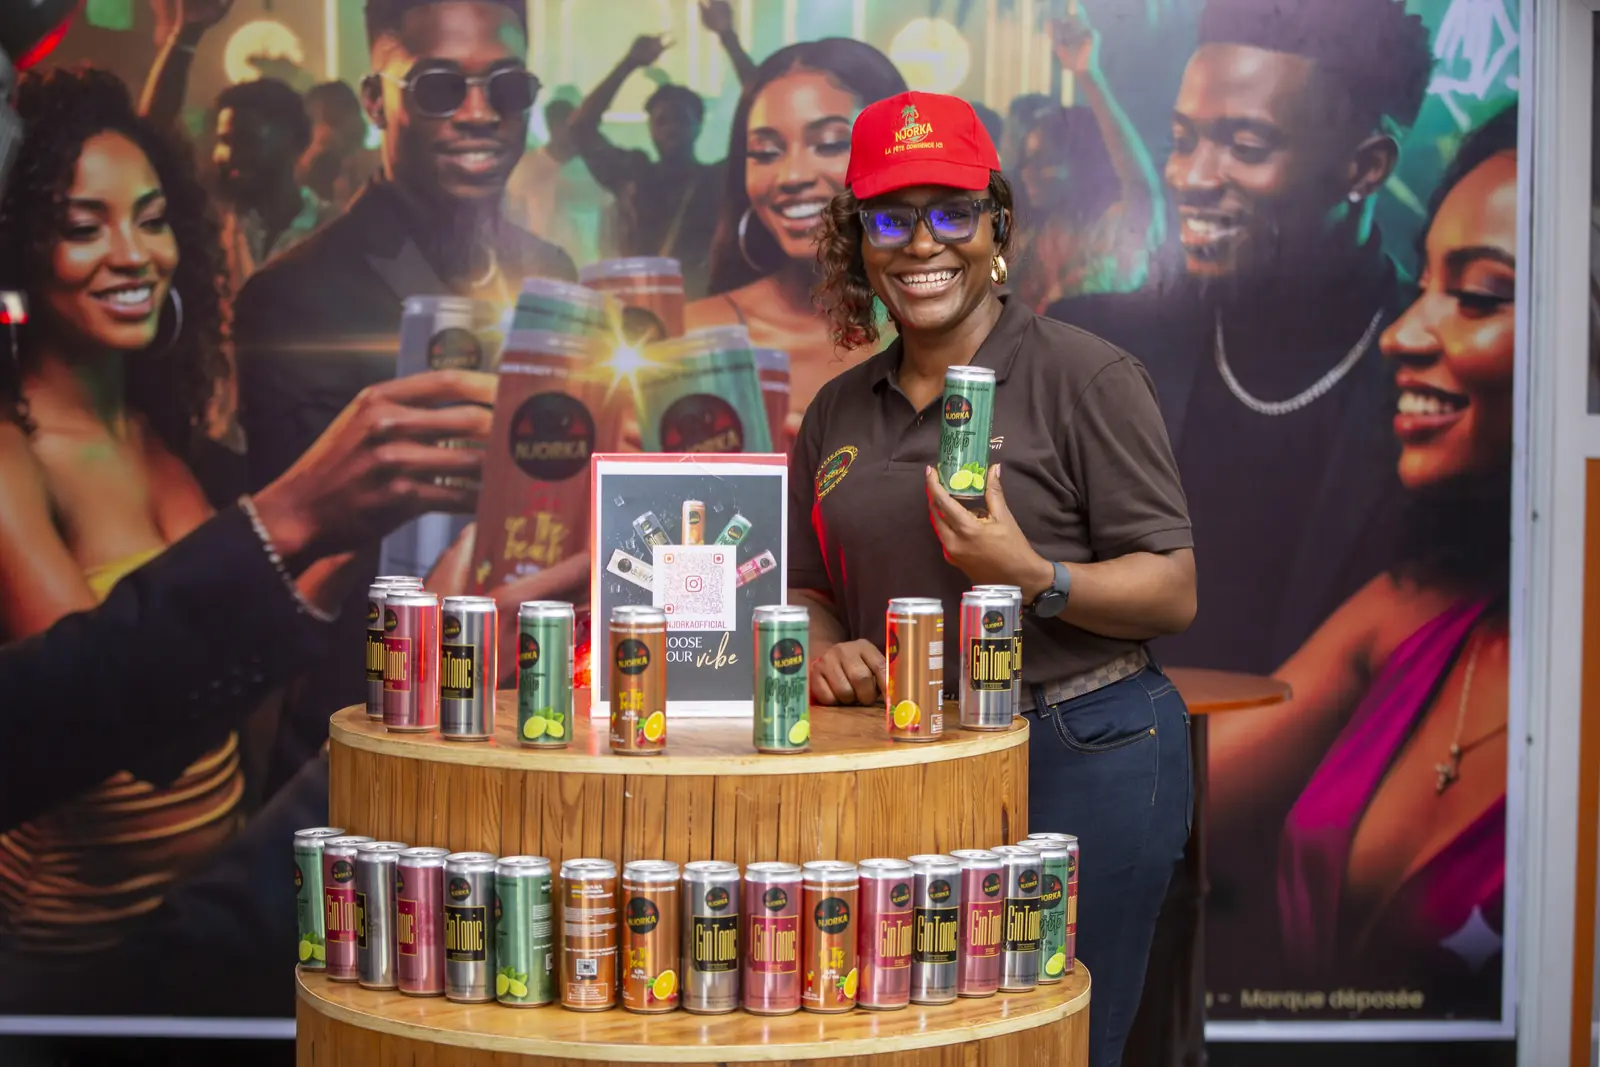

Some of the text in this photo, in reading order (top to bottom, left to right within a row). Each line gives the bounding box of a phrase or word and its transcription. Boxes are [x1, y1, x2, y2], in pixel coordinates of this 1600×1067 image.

[895, 123, 933, 142] NJORKA
[885, 147, 892, 155] LA
[945, 411, 970, 420] NJORKA
[514, 440, 588, 461] NJORKA
[665, 636, 703, 649] OOSE
[665, 631, 739, 670] OUR vibe
[618, 656, 648, 669] NJORKA
[774, 655, 803, 669] NJORKA
[1040, 890, 1061, 903] ORKA
[627, 915, 657, 927] NJORKA
[817, 914, 848, 927] NJORKA
[1240, 989, 1325, 1012] Marque
[1328, 988, 1424, 1012] déposée
